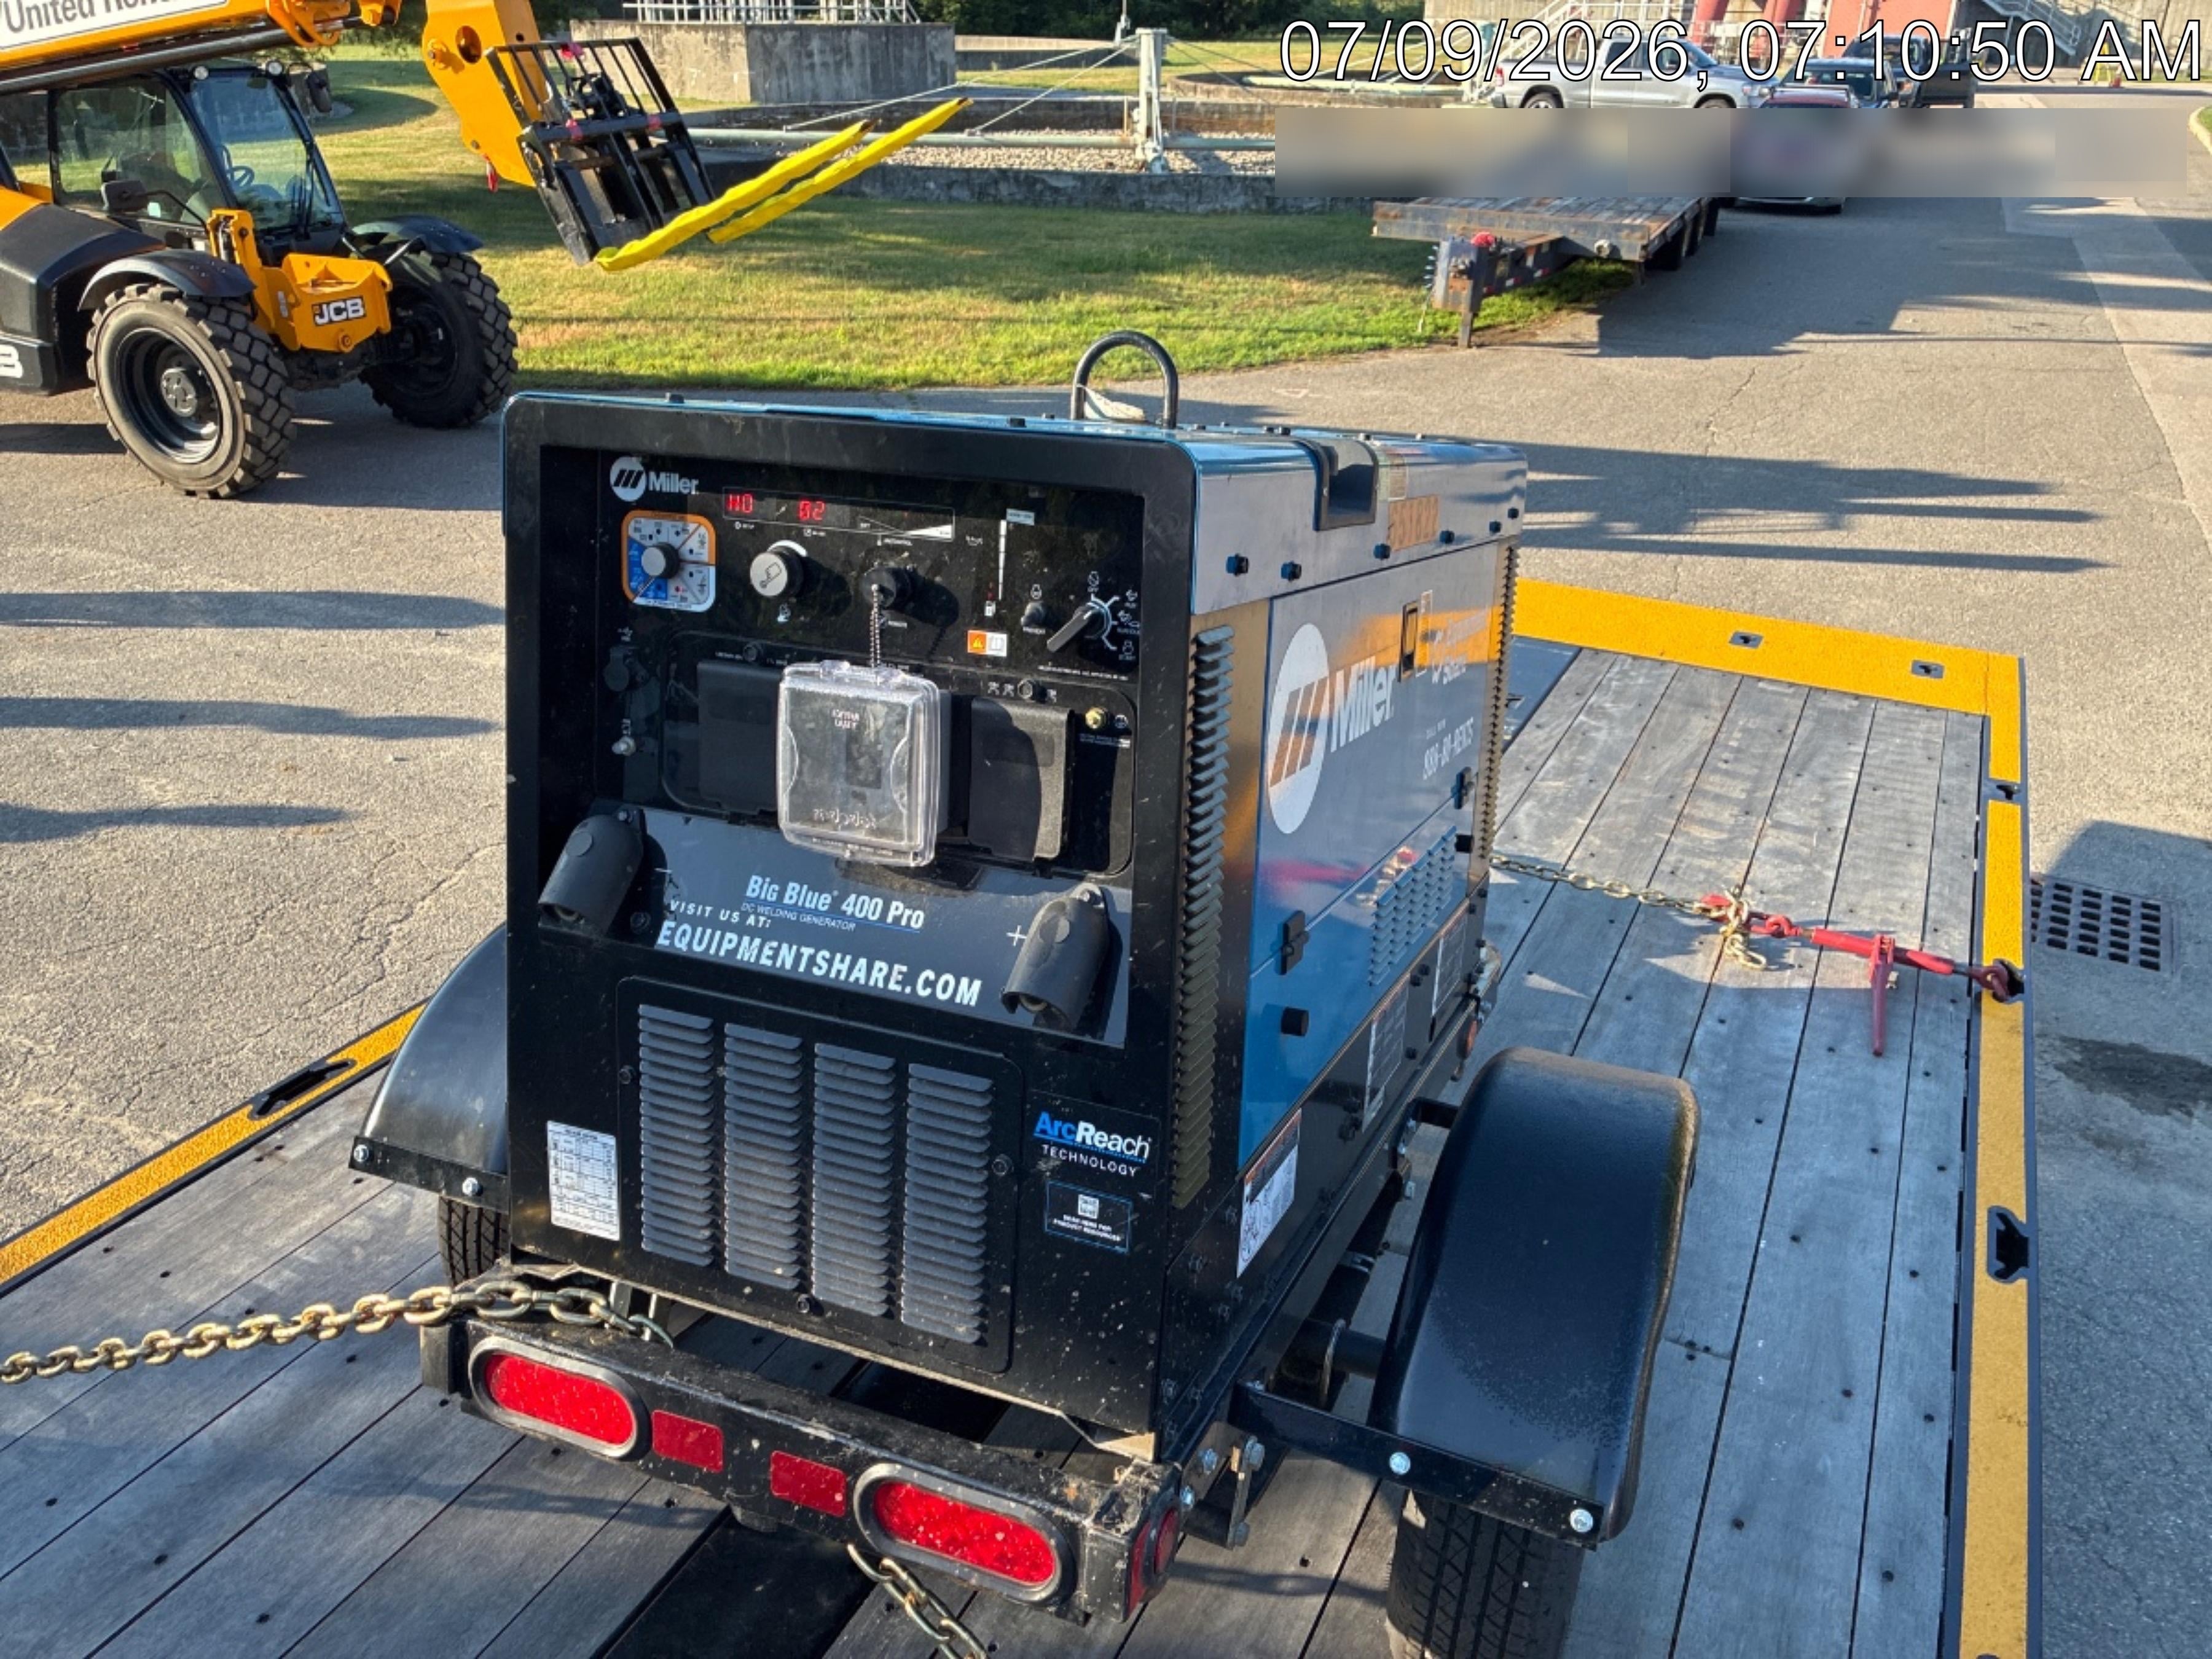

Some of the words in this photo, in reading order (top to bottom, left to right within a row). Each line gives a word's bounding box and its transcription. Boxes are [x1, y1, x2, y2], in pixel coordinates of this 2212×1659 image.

[4, 0, 96, 33] United
[315, 298, 364, 325] JCB
[649, 471, 699, 495] Miller
[1330, 656, 1396, 752] Miller
[670, 900, 713, 919] VISIT
[719, 909, 740, 923] US
[746, 914, 772, 928] AT:
[740, 903, 756, 912] DC
[756, 906, 798, 921] WELDING
[799, 913, 856, 931] GENERATOR
[841, 893, 883, 921] 400
[887, 900, 924, 930] Pro
[657, 920, 983, 1007] EQUIPMENTSHARE.COM
[1035, 1111, 1150, 1159] ArcReach
[1041, 1144, 1138, 1177] TECHNOLOGY
